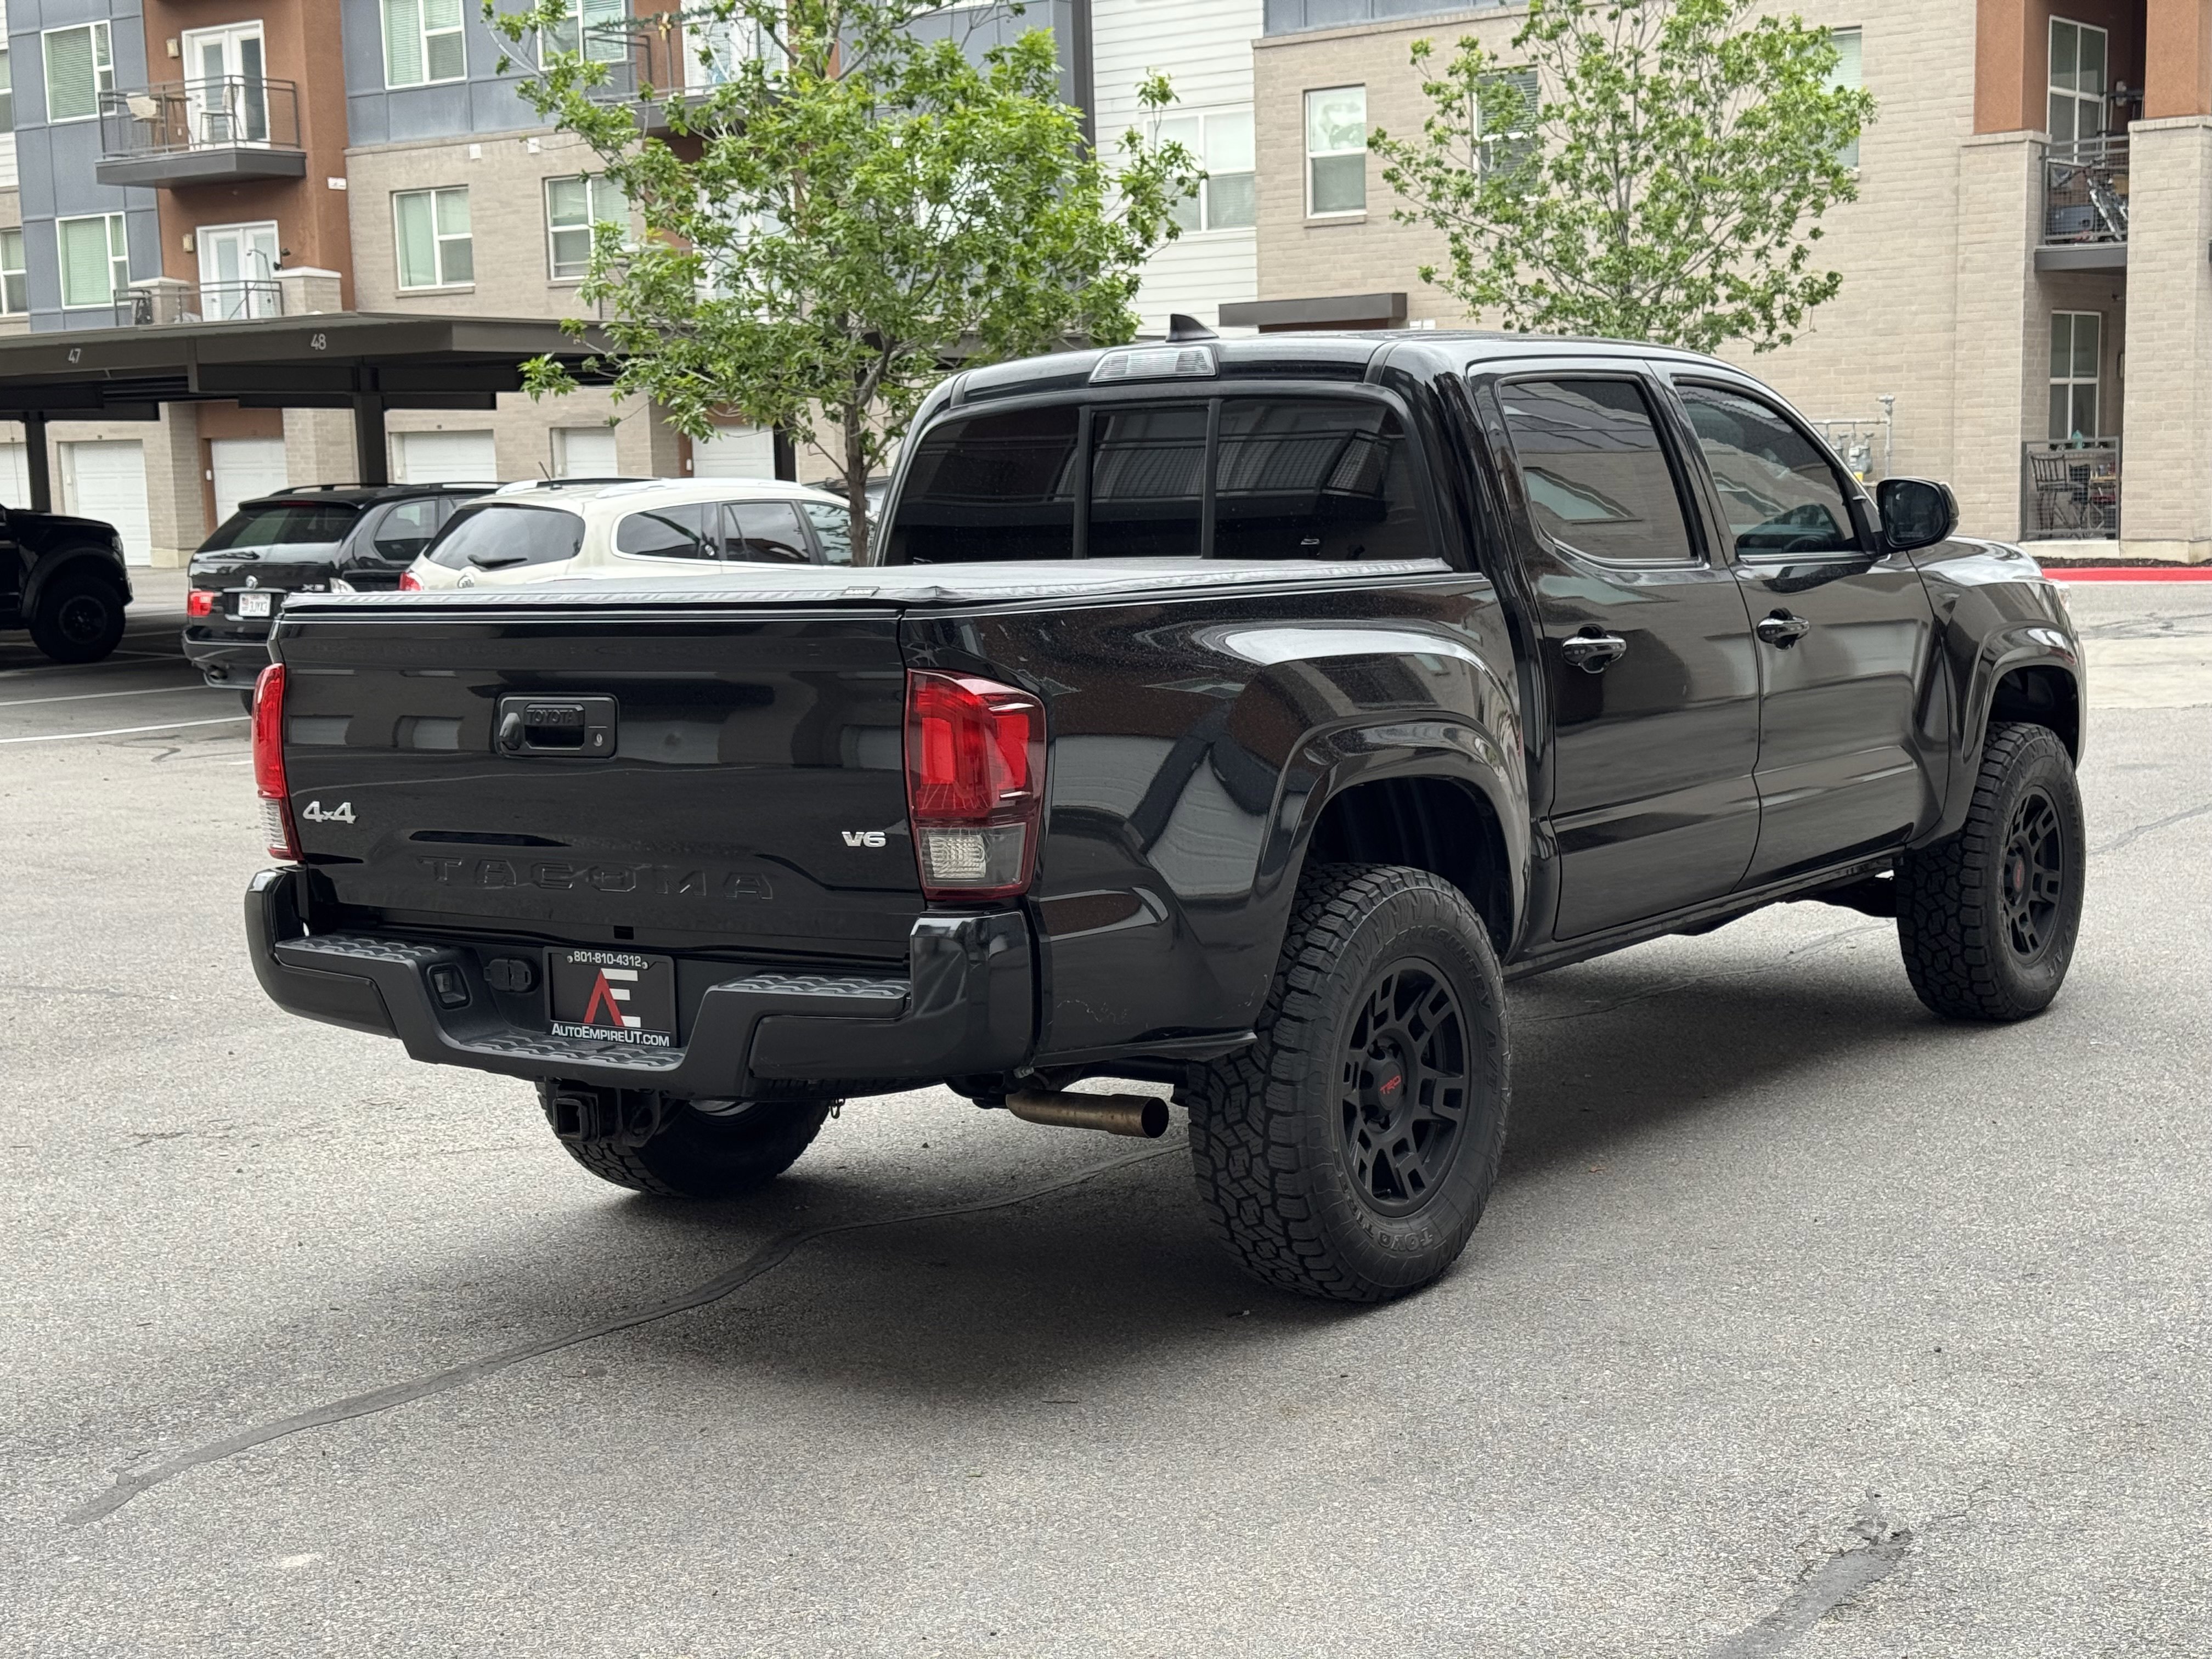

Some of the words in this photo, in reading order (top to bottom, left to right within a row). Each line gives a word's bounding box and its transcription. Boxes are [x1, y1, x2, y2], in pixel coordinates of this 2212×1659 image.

[311, 334, 326, 350] 48
[68, 348, 81, 363] 47
[526, 709, 574, 725] TOYOTA
[842, 831, 886, 848] V6
[417, 856, 772, 900] TACOMA
[574, 951, 641, 967] 801-810-4312
[1422, 925, 1493, 1011] COUNTRY
[1379, 1075, 1401, 1094] TRD
